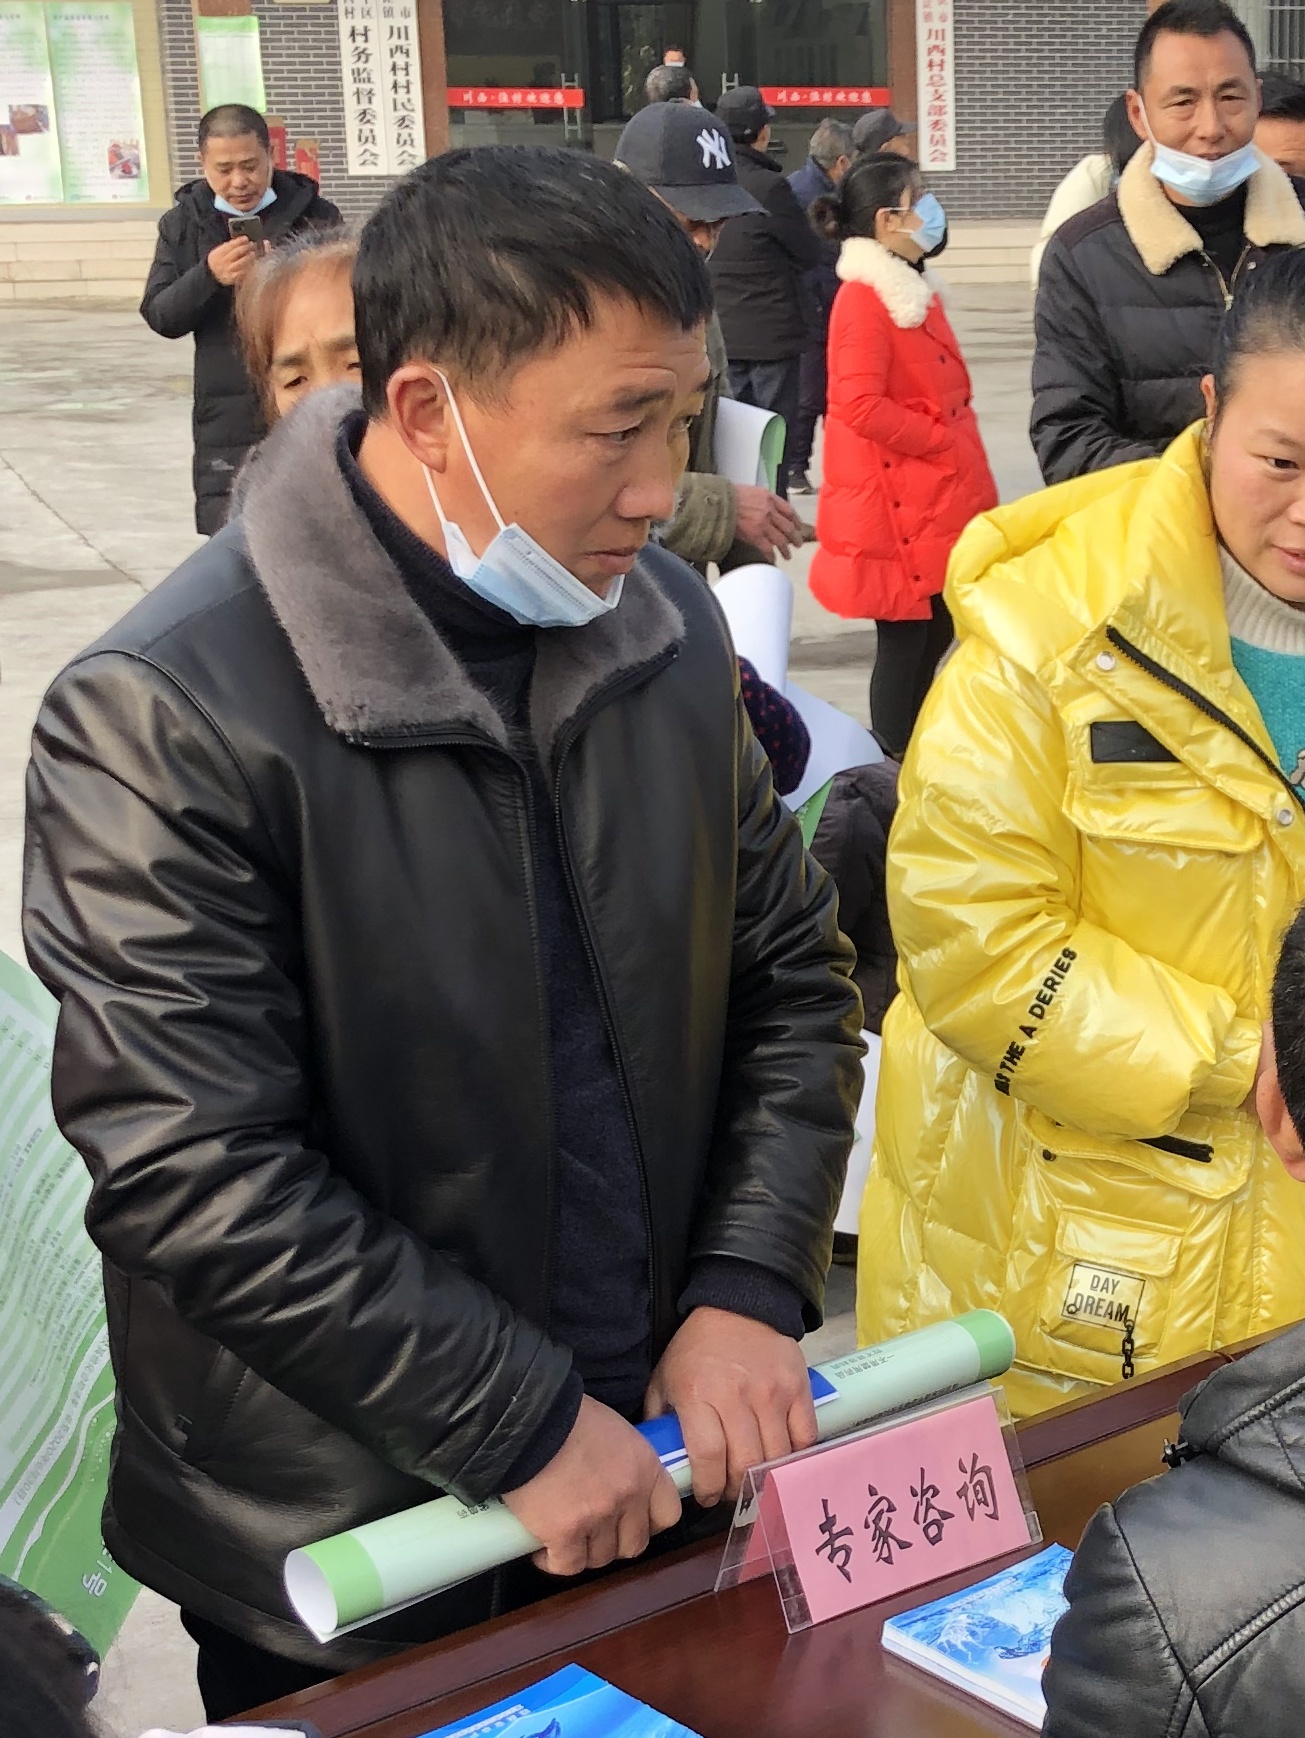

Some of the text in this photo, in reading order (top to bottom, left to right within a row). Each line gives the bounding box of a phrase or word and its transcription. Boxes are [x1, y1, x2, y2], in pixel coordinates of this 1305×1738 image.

[347, 25, 380, 167] 村务监督委员会
[386, 25, 418, 167] 川西村村民委员会
[695, 128, 731, 169] NY
[1028, 946, 1078, 1020] DERIES
[1019, 1024, 1038, 1039] A
[1074, 1293, 1130, 1322] DREAM
[1089, 1274, 1120, 1295] DAY
[815, 1452, 999, 1583] 专家咨询
